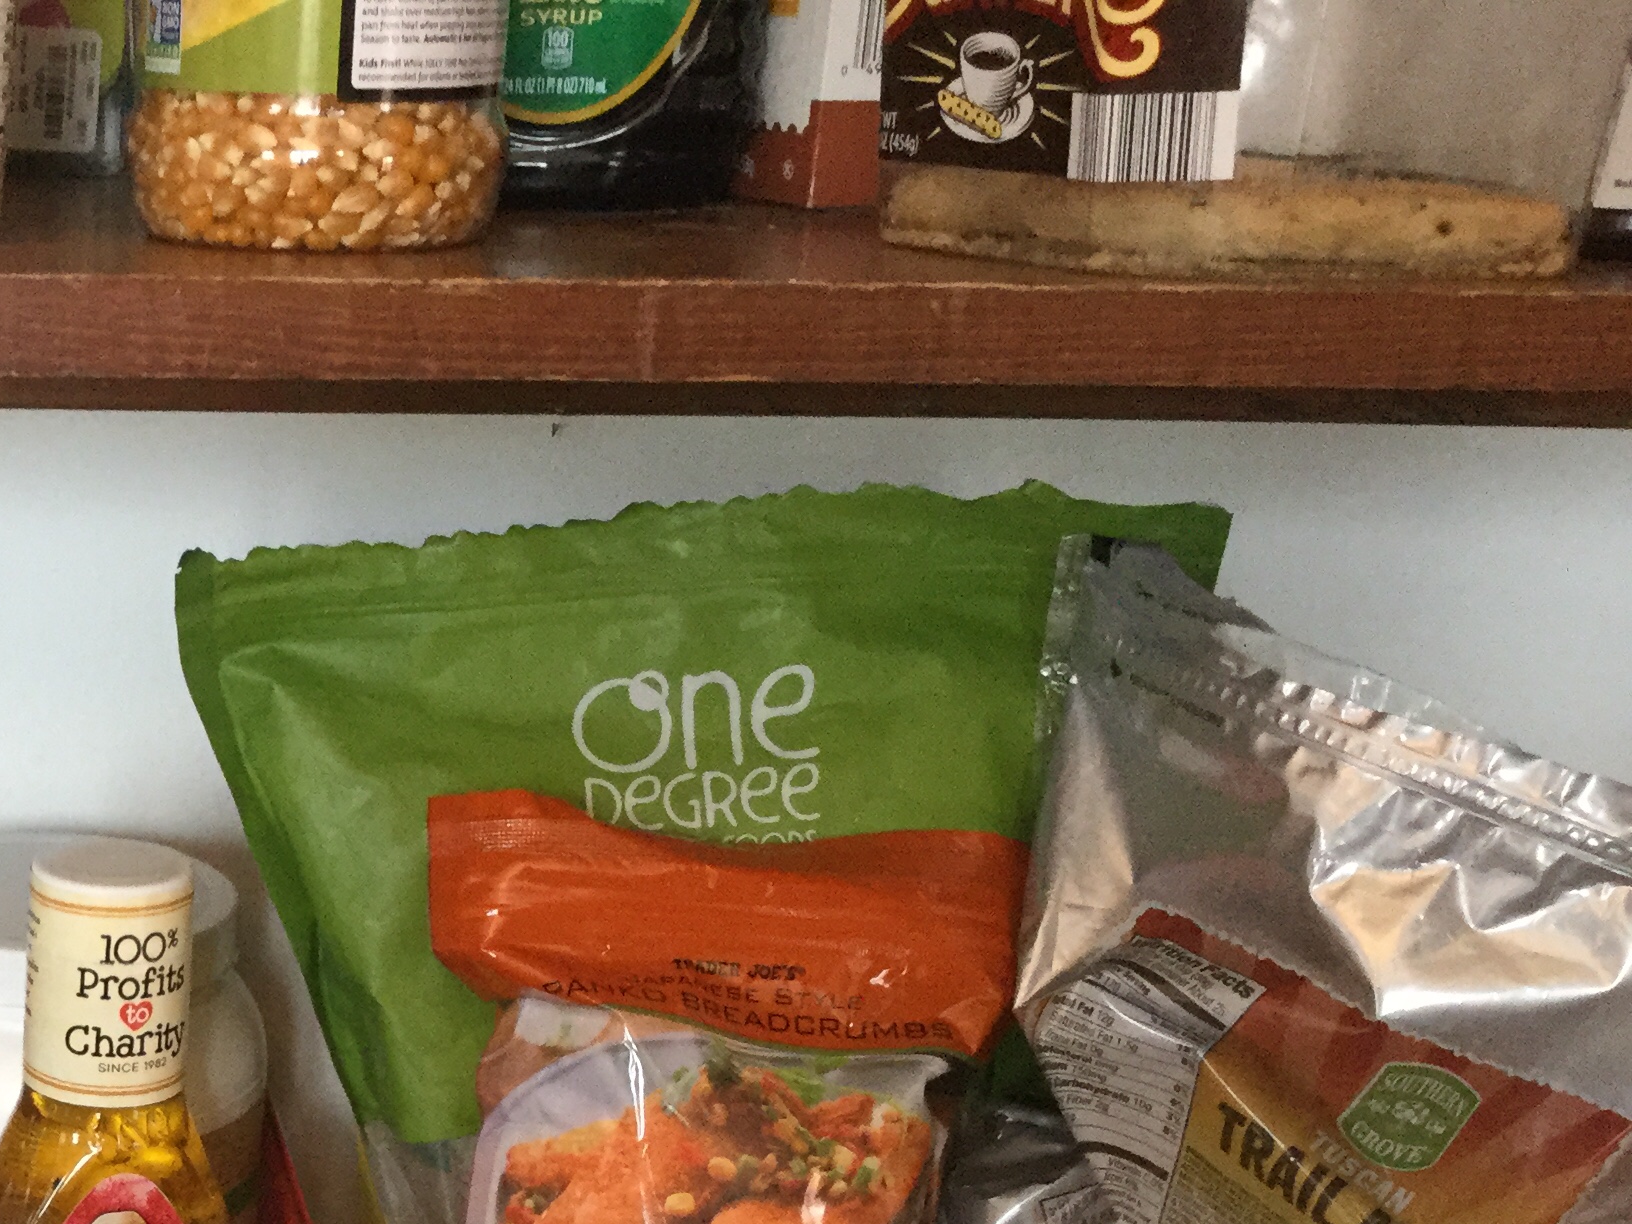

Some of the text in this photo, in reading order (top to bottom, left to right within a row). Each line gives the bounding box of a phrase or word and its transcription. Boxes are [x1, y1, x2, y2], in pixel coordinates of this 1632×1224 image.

[520, 8, 603, 27] SYRUP
[548, 28, 569, 47] 100
[99, 927, 179, 966] 100%
[76, 963, 185, 1001] Profits
[672, 958, 742, 977] TRADER
[1200, 964, 1256, 999] Facts
[125, 1003, 150, 1024] to
[680, 990, 953, 1040] BREADCRUMBS
[773, 987, 864, 1011] STYLE
[65, 1022, 185, 1059] Charity
[97, 1056, 168, 1073] SINCE 1982
[1383, 1072, 1466, 1120] SOUTHERN
[1349, 1120, 1430, 1165] GROVE
[1309, 1130, 1418, 1216] TUSCAN
